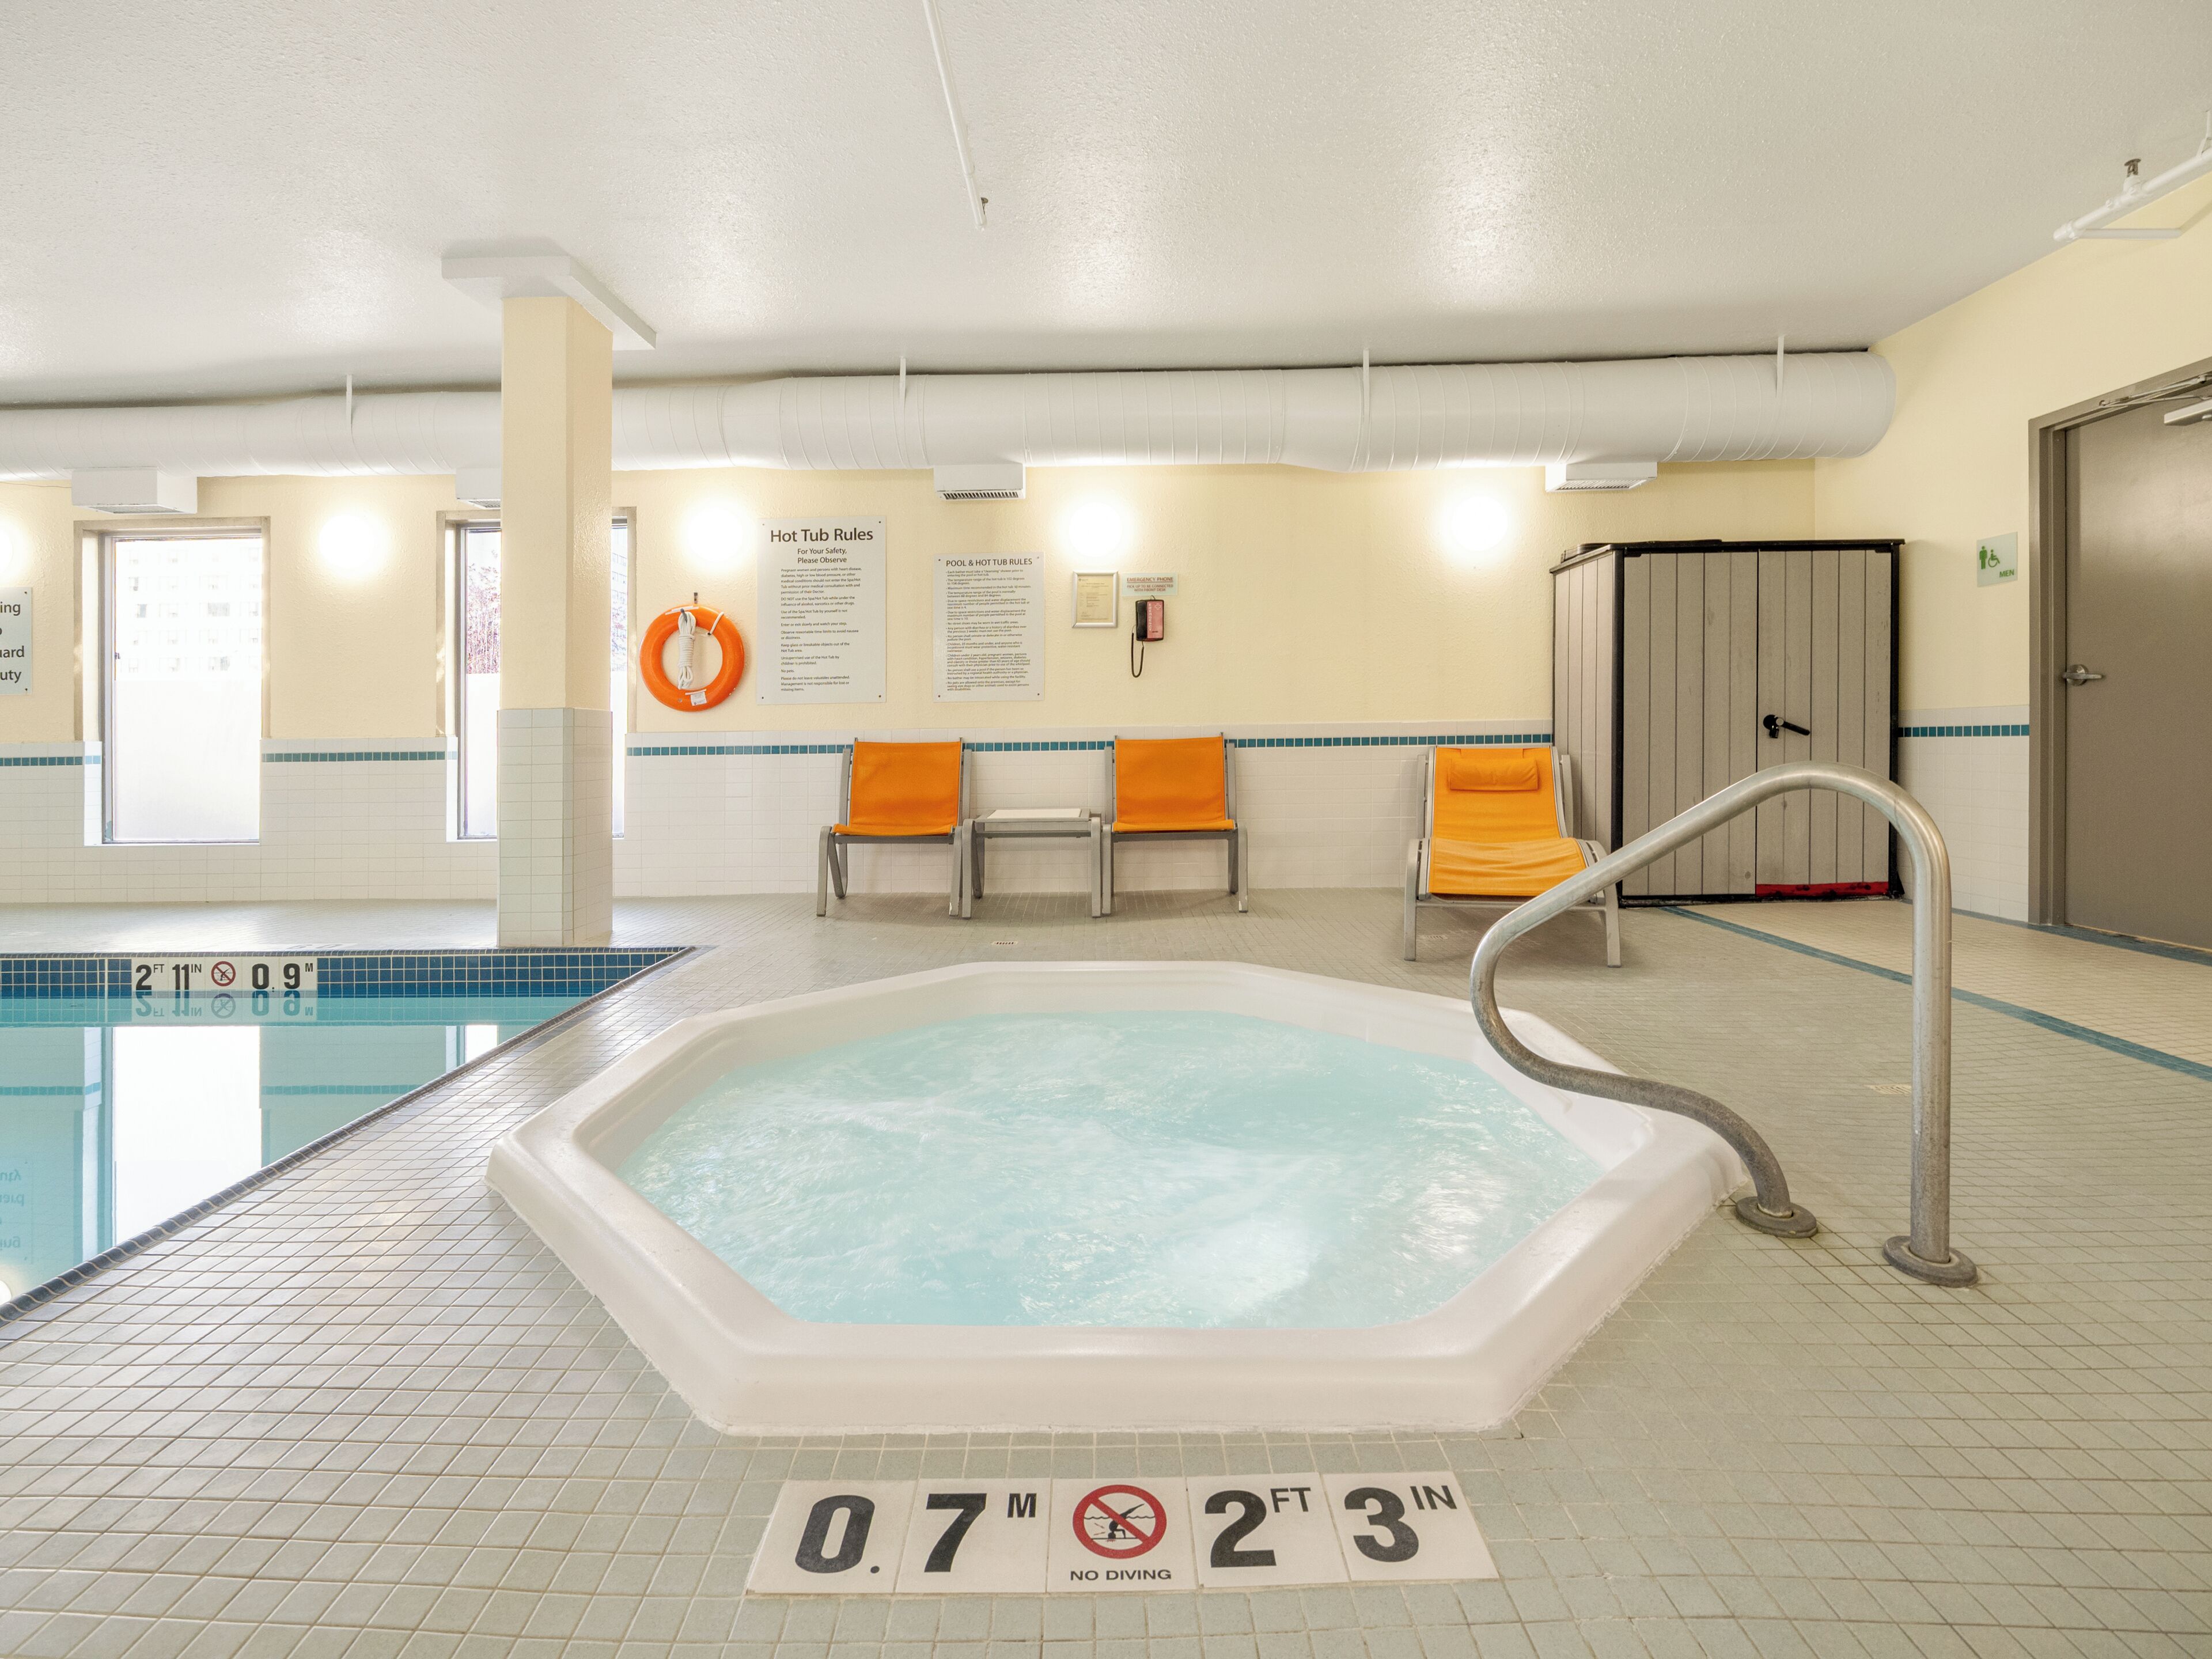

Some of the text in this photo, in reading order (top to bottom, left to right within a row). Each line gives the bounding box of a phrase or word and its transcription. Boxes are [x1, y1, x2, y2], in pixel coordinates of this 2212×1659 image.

[771, 527, 873, 543] Hot Tub Rules
[825, 547, 847, 555] Safety,
[1999, 569, 2014, 578] MEN
[135, 964, 152, 990] 2
[153, 964, 165, 974] FT
[172, 964, 190, 990] 11
[191, 964, 202, 973] IN
[283, 963, 300, 990] 9
[305, 963, 313, 972] M
[795, 1485, 1457, 1574] 0. 7 M 2 FT 3 IN
[1070, 1569, 1172, 1581] NO DIVING
